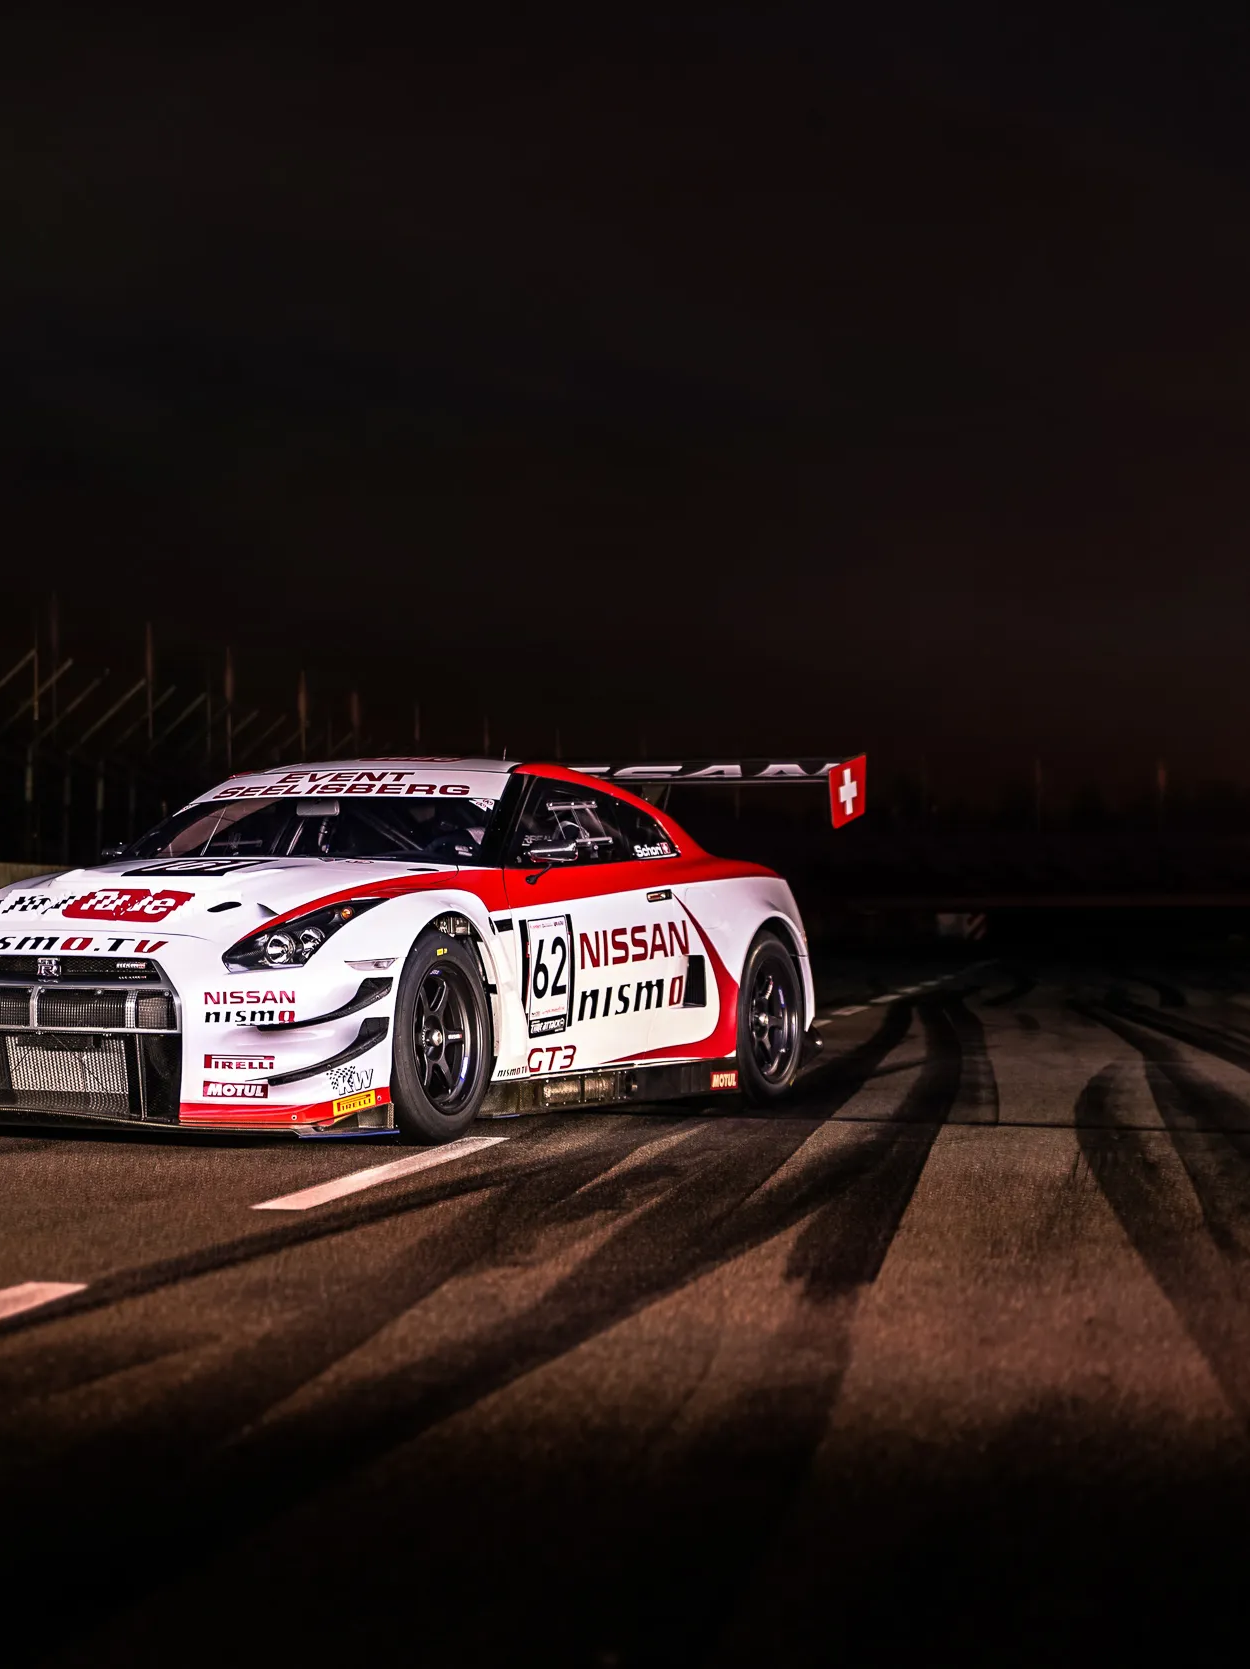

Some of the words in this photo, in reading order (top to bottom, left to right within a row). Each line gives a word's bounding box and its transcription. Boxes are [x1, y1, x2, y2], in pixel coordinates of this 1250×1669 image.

[276, 772, 414, 785] EVENT
[213, 784, 470, 799] SEELISBERG
[633, 843, 663, 858] Schori
[579, 920, 690, 970] NISSAN
[532, 936, 567, 999] 62
[204, 990, 296, 1005] NISSAN
[577, 975, 684, 1022] nismo
[204, 1010, 296, 1023] nismo
[204, 1054, 275, 1070] PIRELLI
[527, 1045, 577, 1073] GT3
[338, 1068, 374, 1096] KW
[712, 1073, 737, 1088] MOTUL
[206, 1083, 264, 1098] MOTUL
[336, 1093, 371, 1112] PIRELLI
